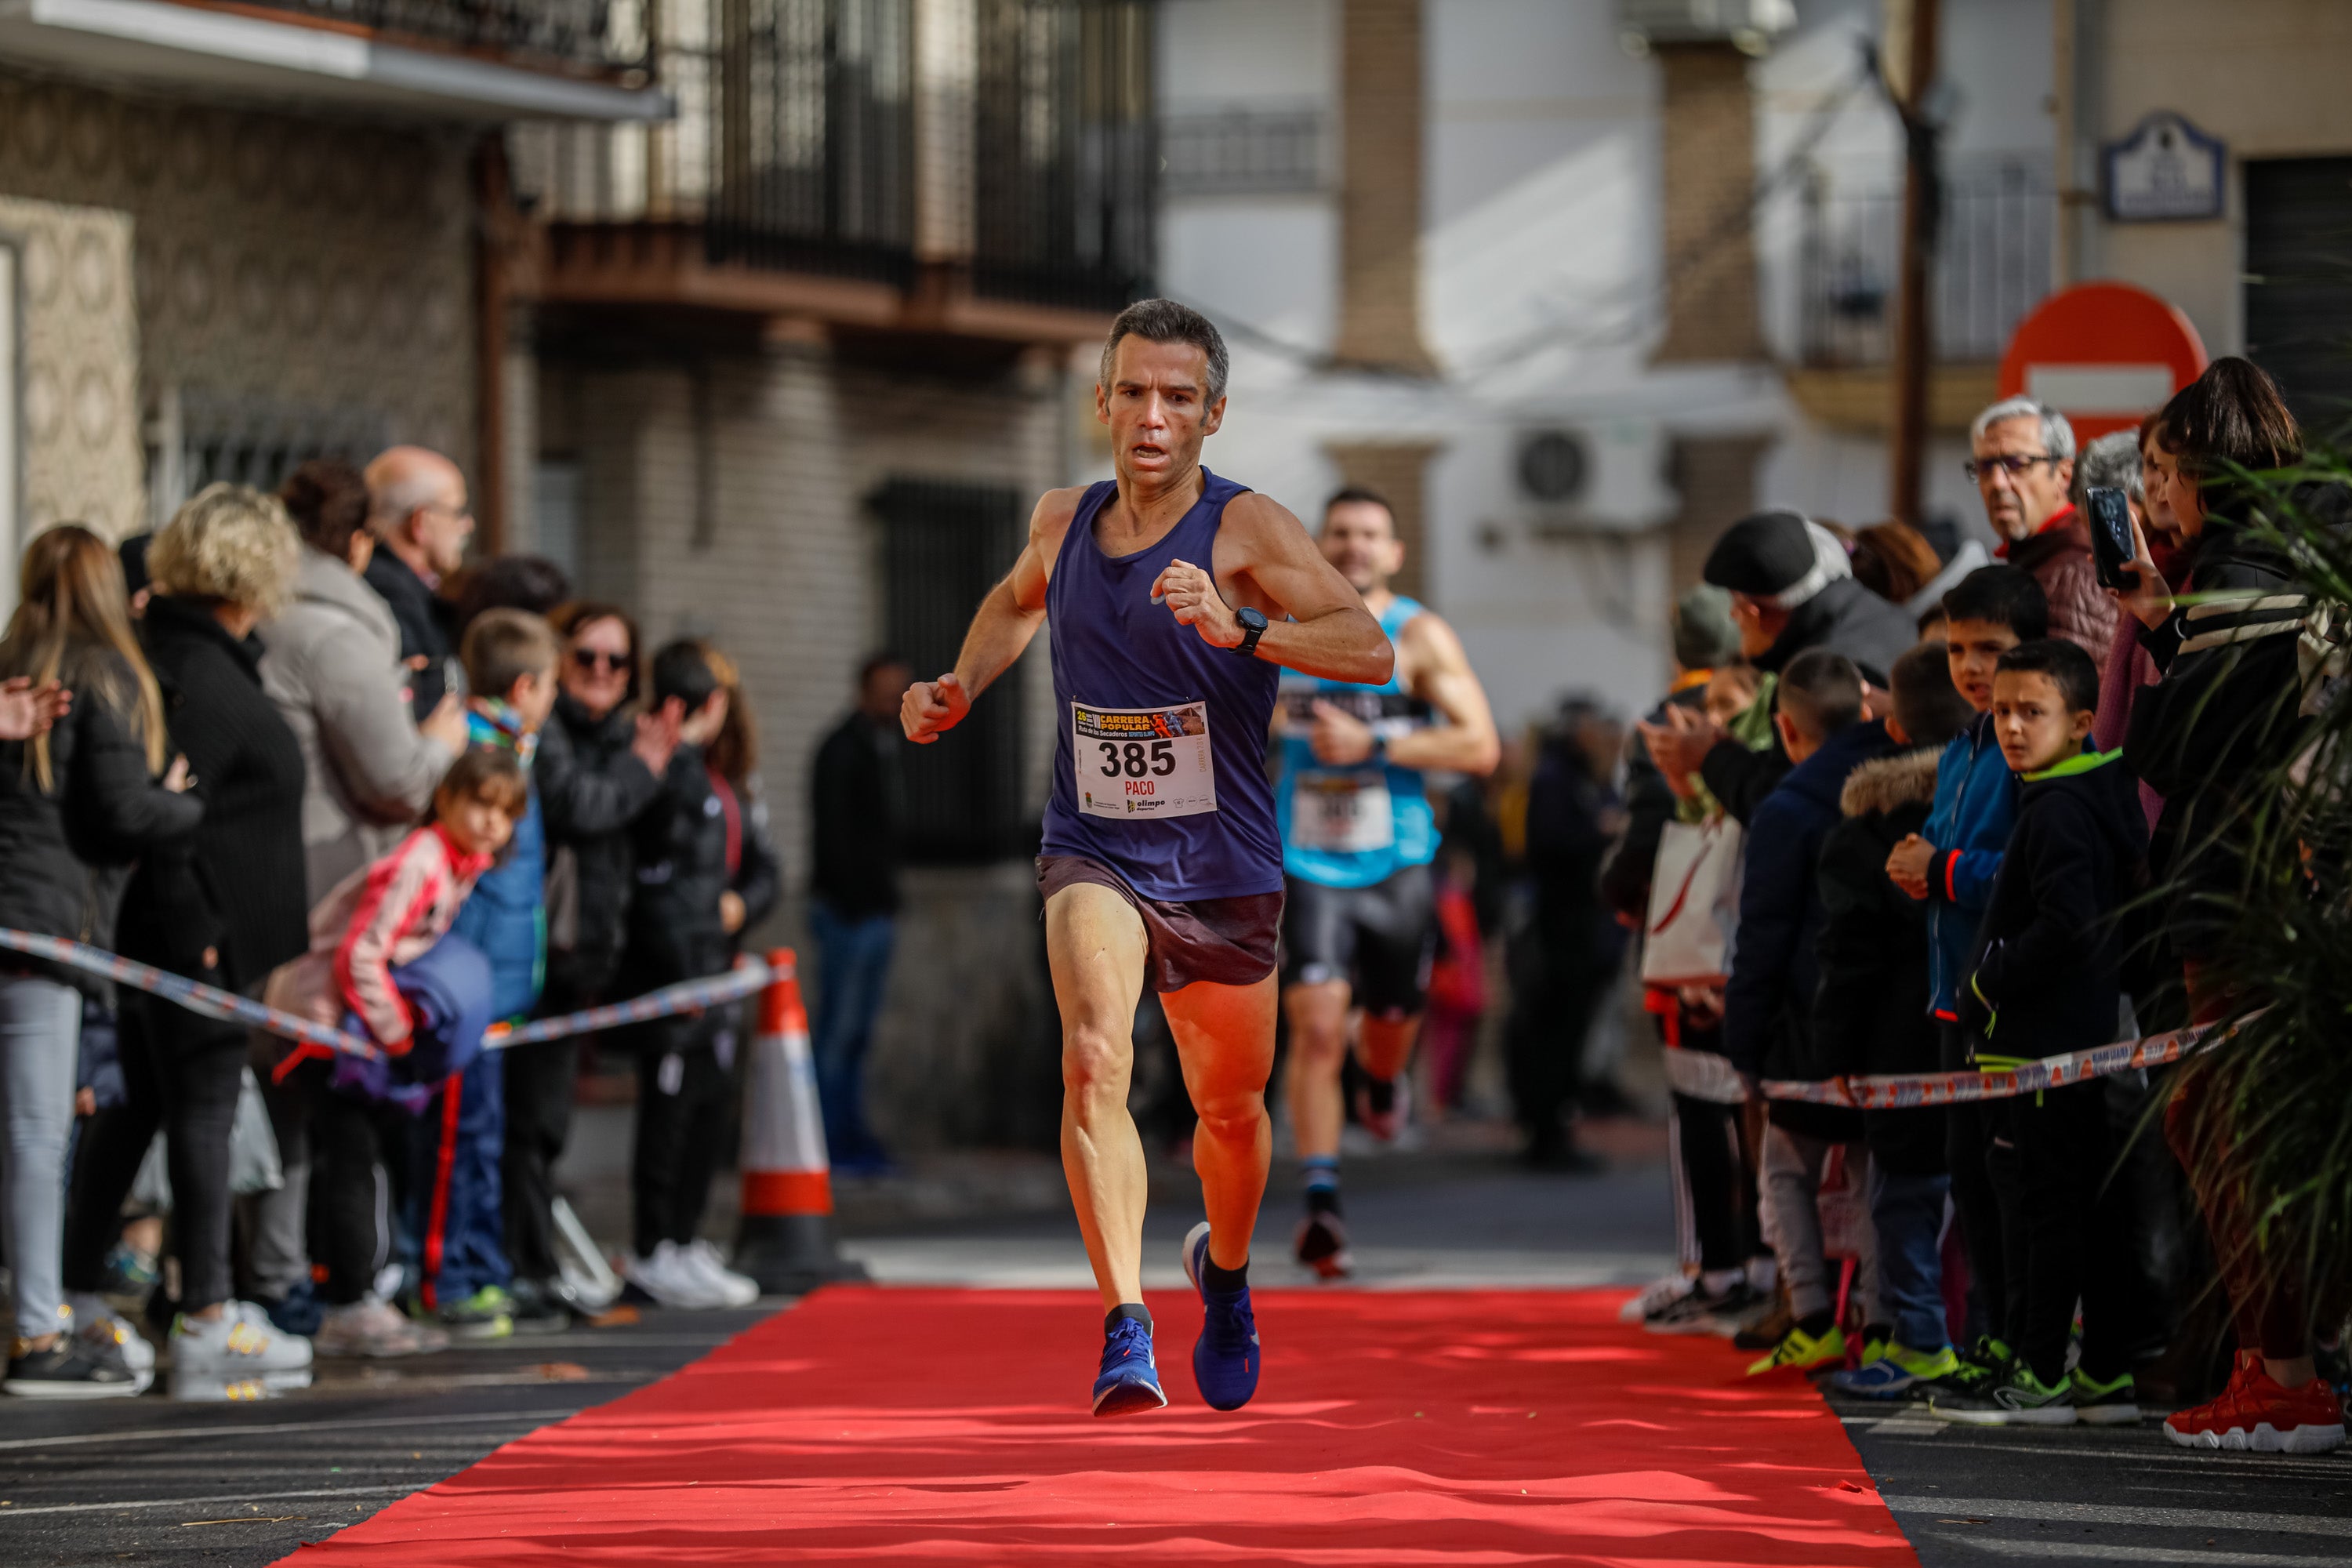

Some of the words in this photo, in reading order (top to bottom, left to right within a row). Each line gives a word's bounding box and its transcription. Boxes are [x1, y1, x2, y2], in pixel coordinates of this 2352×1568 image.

[1077, 710, 1087, 721] 26
[1100, 715, 1150, 724] CARRERA
[1098, 739, 1176, 778] 385
[1125, 780, 1155, 796] PACO
[1137, 799, 1166, 808] olimpo
